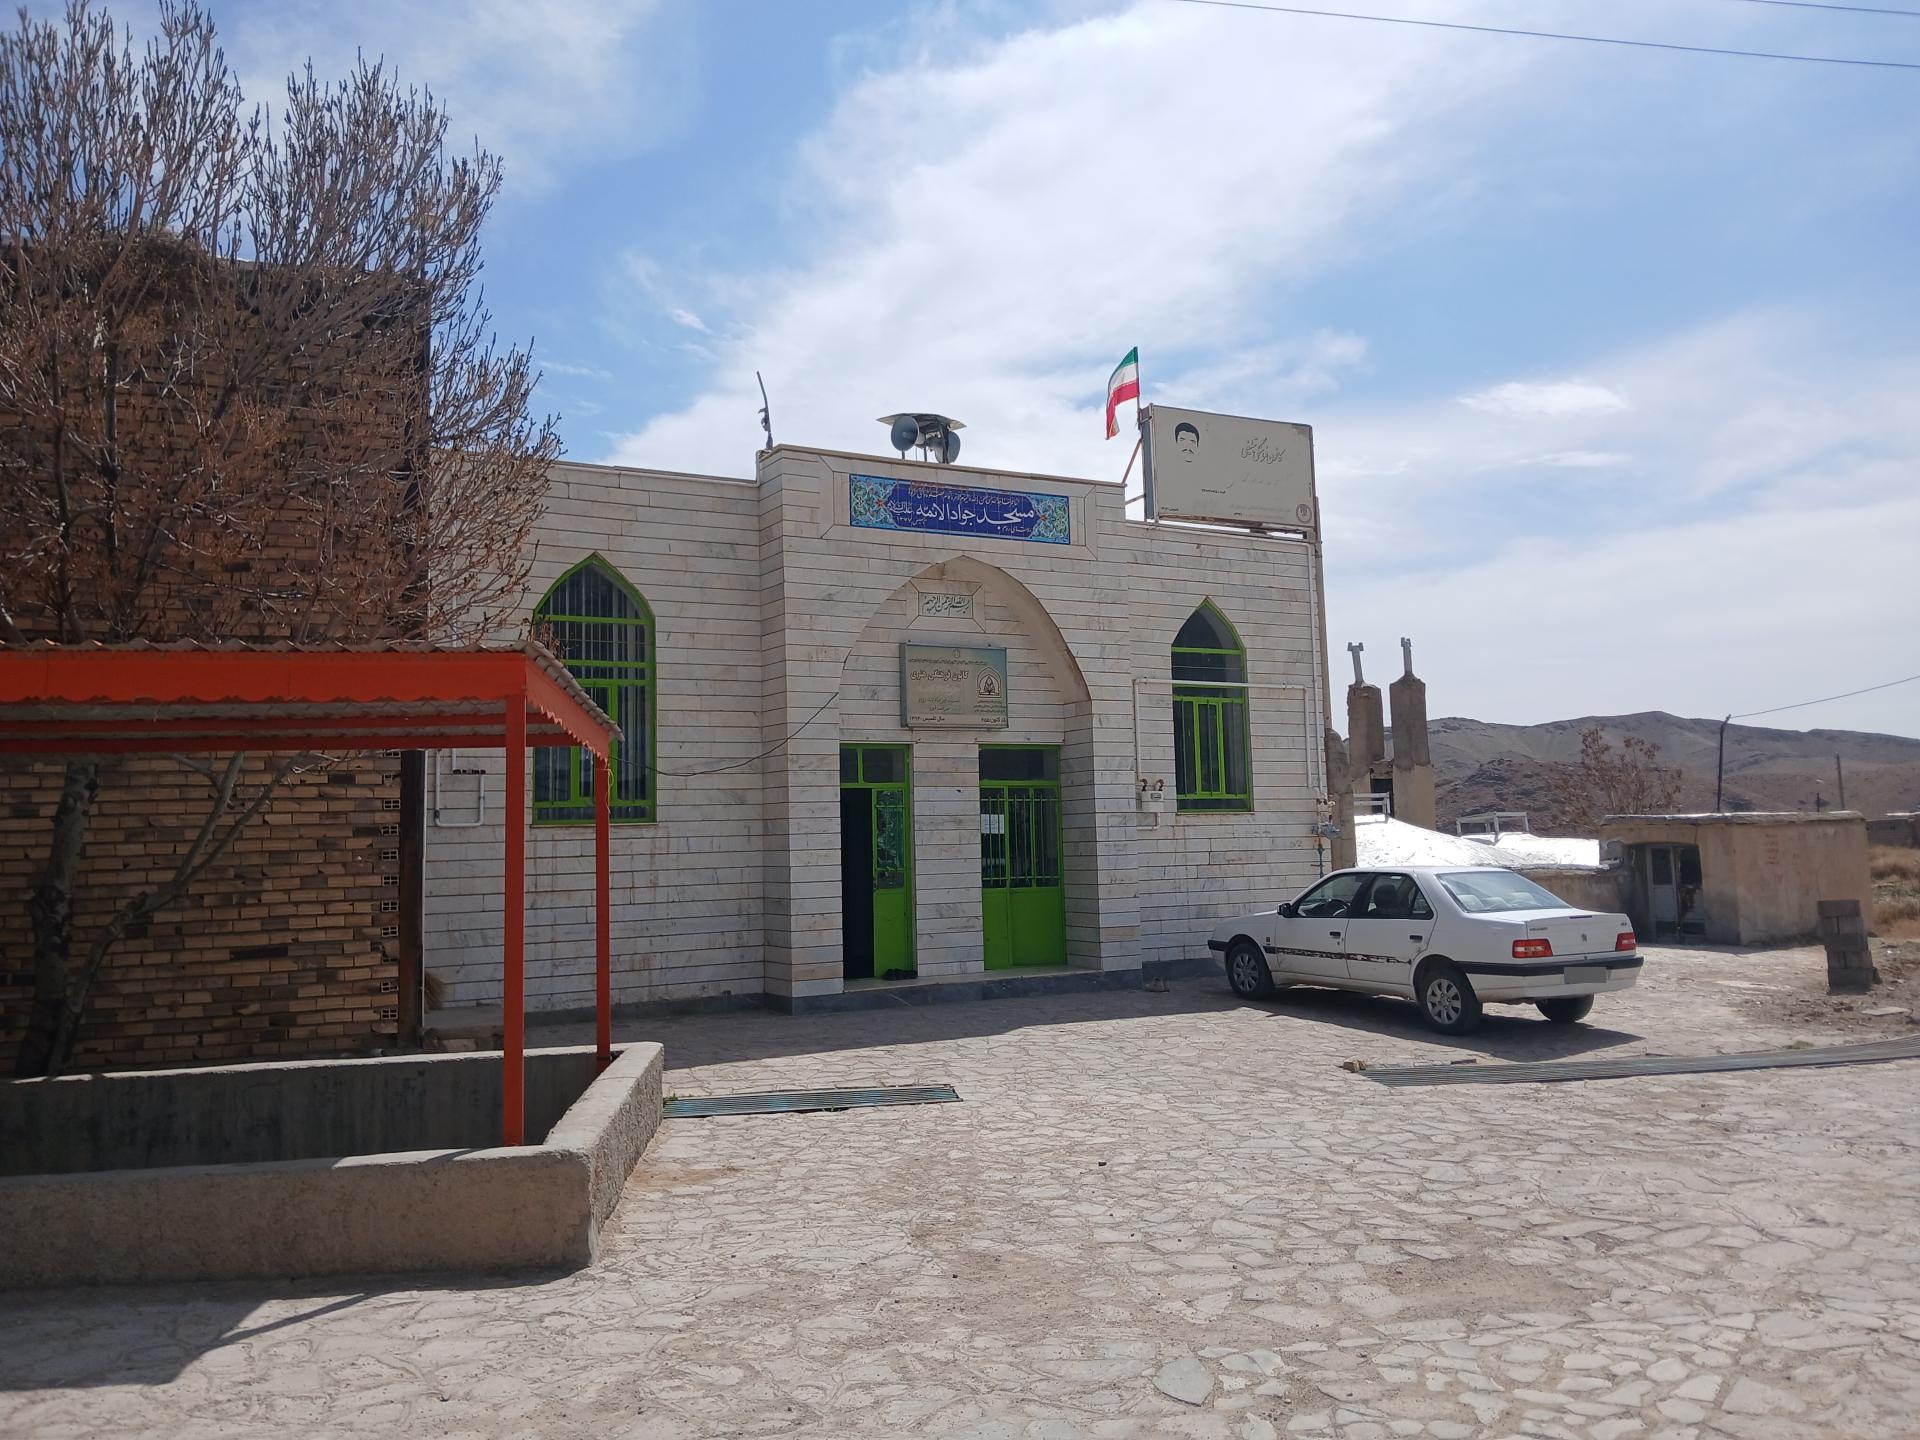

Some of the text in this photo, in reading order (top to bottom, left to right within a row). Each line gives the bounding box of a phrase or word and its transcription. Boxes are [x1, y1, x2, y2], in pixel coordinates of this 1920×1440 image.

[976, 506, 1034, 530] مسجد
[909, 669, 969, 682] کانون فرهنگی هنری
